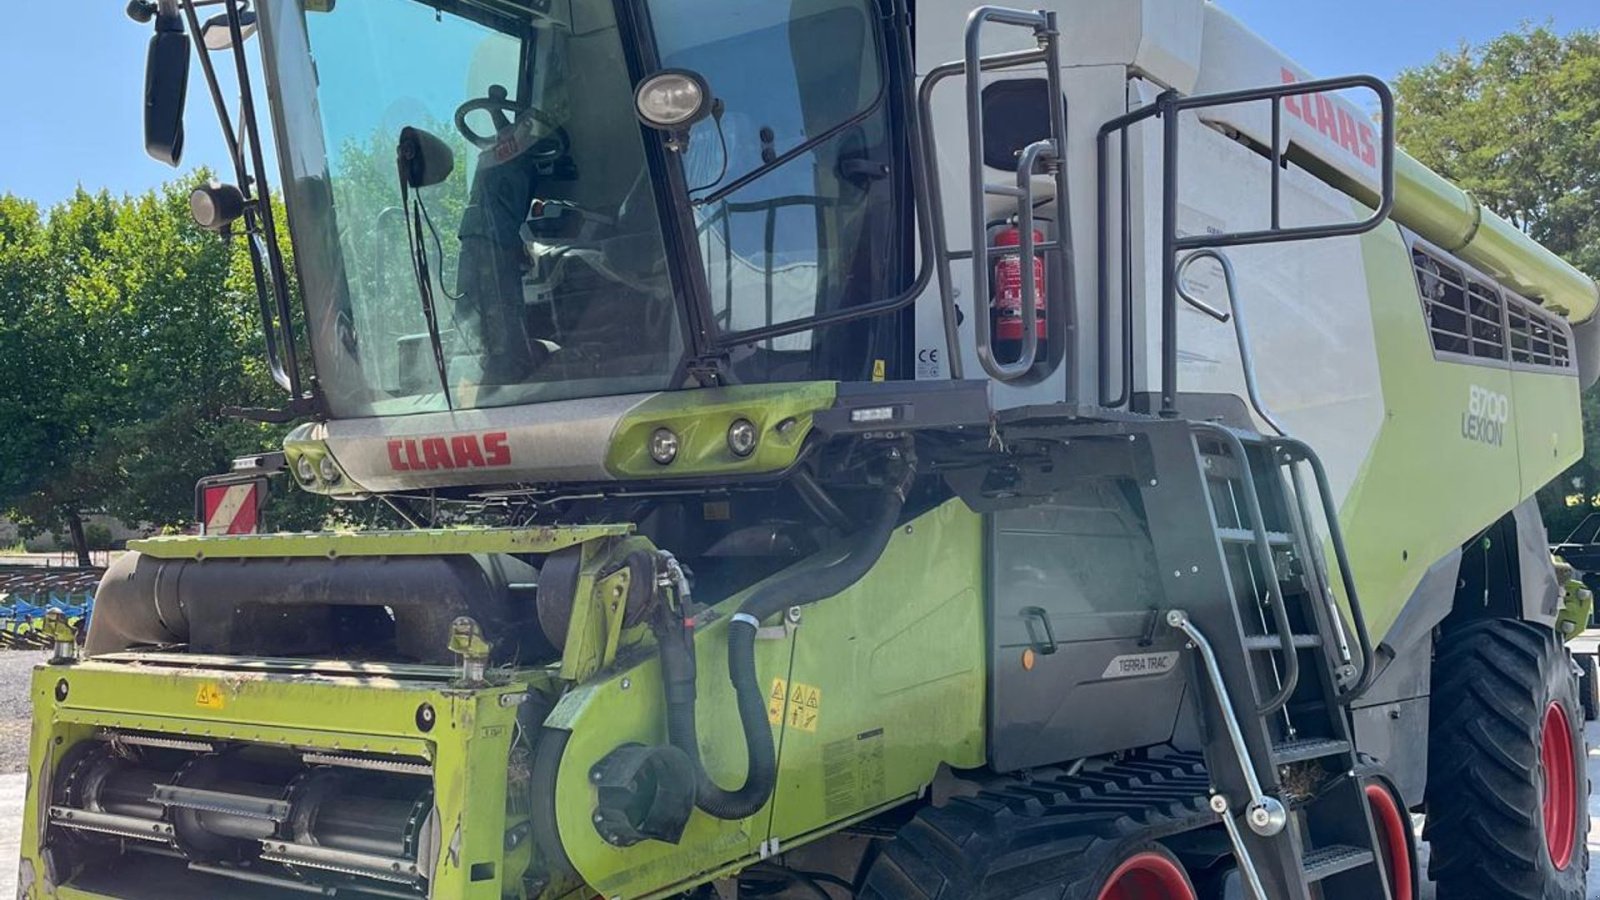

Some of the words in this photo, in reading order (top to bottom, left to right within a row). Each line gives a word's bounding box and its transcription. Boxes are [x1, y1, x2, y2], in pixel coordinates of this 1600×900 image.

[1281, 66, 1376, 168] CLAAS
[1469, 383, 1508, 424] 8700
[1462, 411, 1503, 448] LEXION
[387, 432, 511, 471] CLAAS
[1119, 658, 1146, 672] TERRA
[1147, 656, 1168, 670] TRAC
